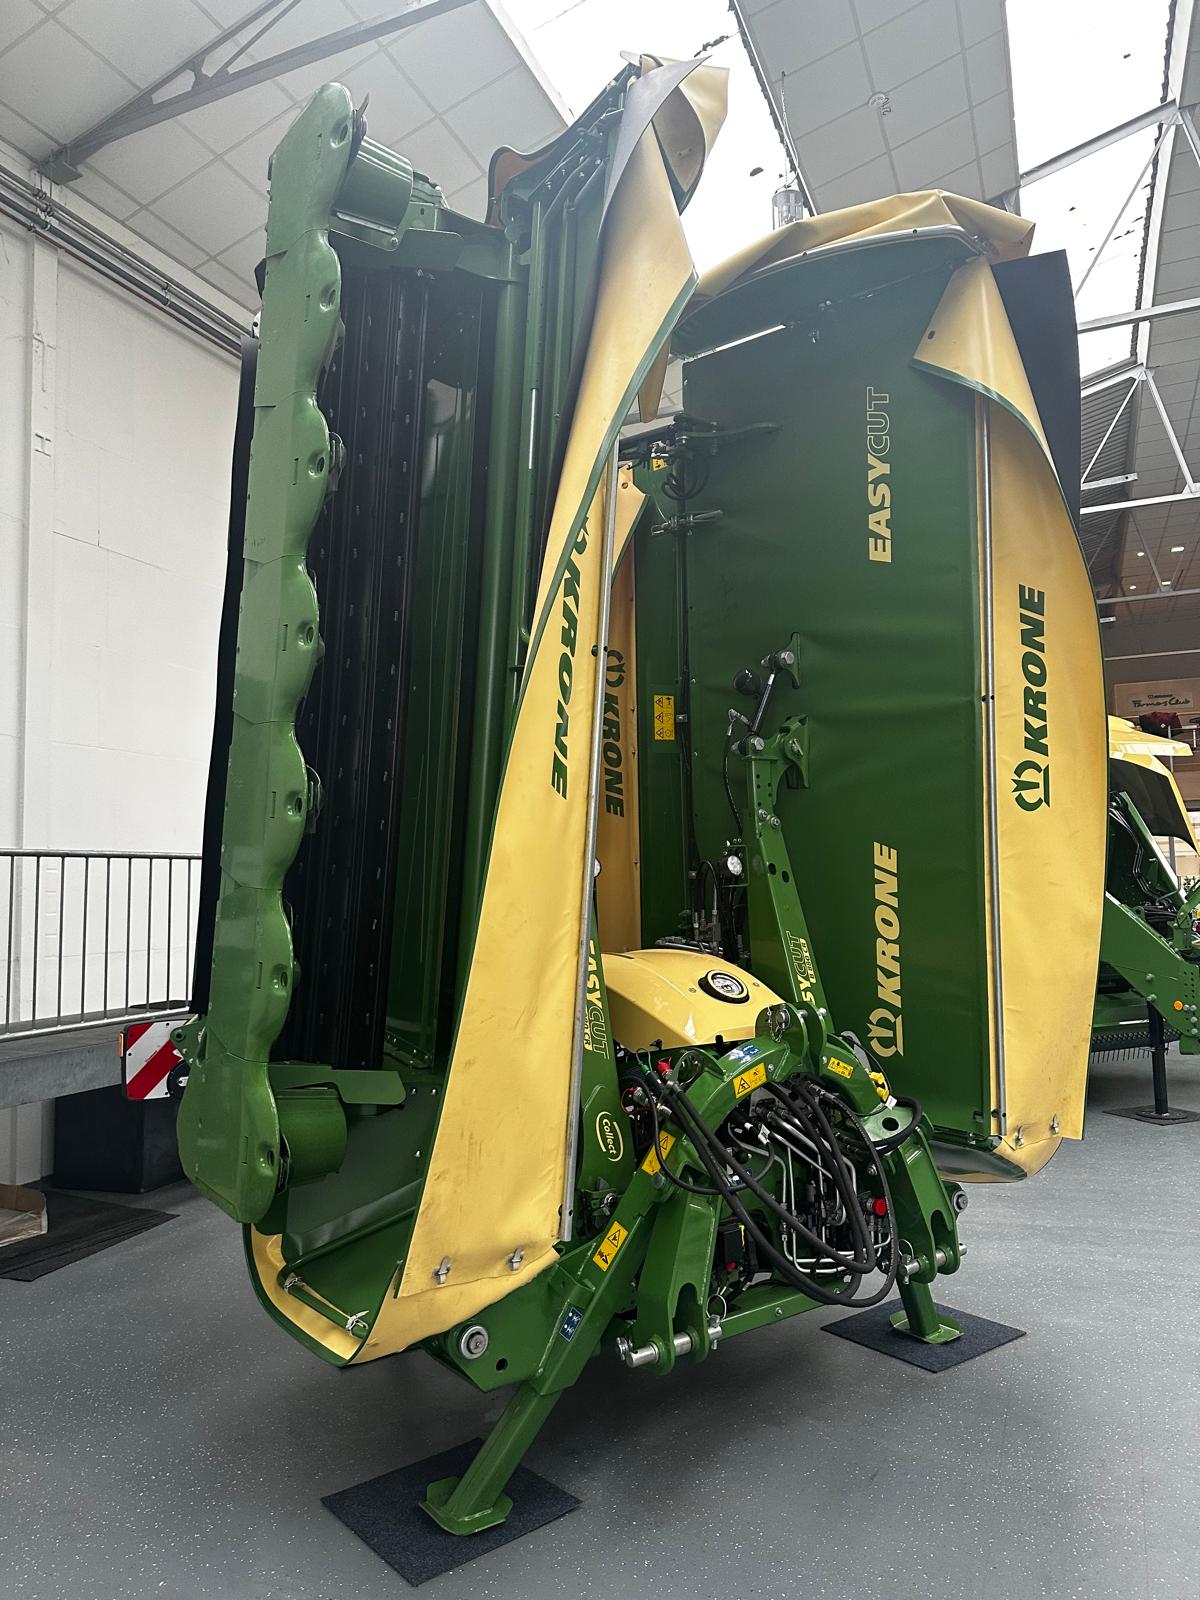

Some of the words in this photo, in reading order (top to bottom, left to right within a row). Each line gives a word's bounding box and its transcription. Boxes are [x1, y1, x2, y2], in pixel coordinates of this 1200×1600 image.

[866, 386, 892, 563] EASYCUT
[551, 556, 581, 800] KRONE
[602, 692, 625, 818] KRONE
[1018, 583, 1049, 757] KRONE
[873, 841, 902, 1009] KRONE
[602, 1118, 617, 1155] Collect
